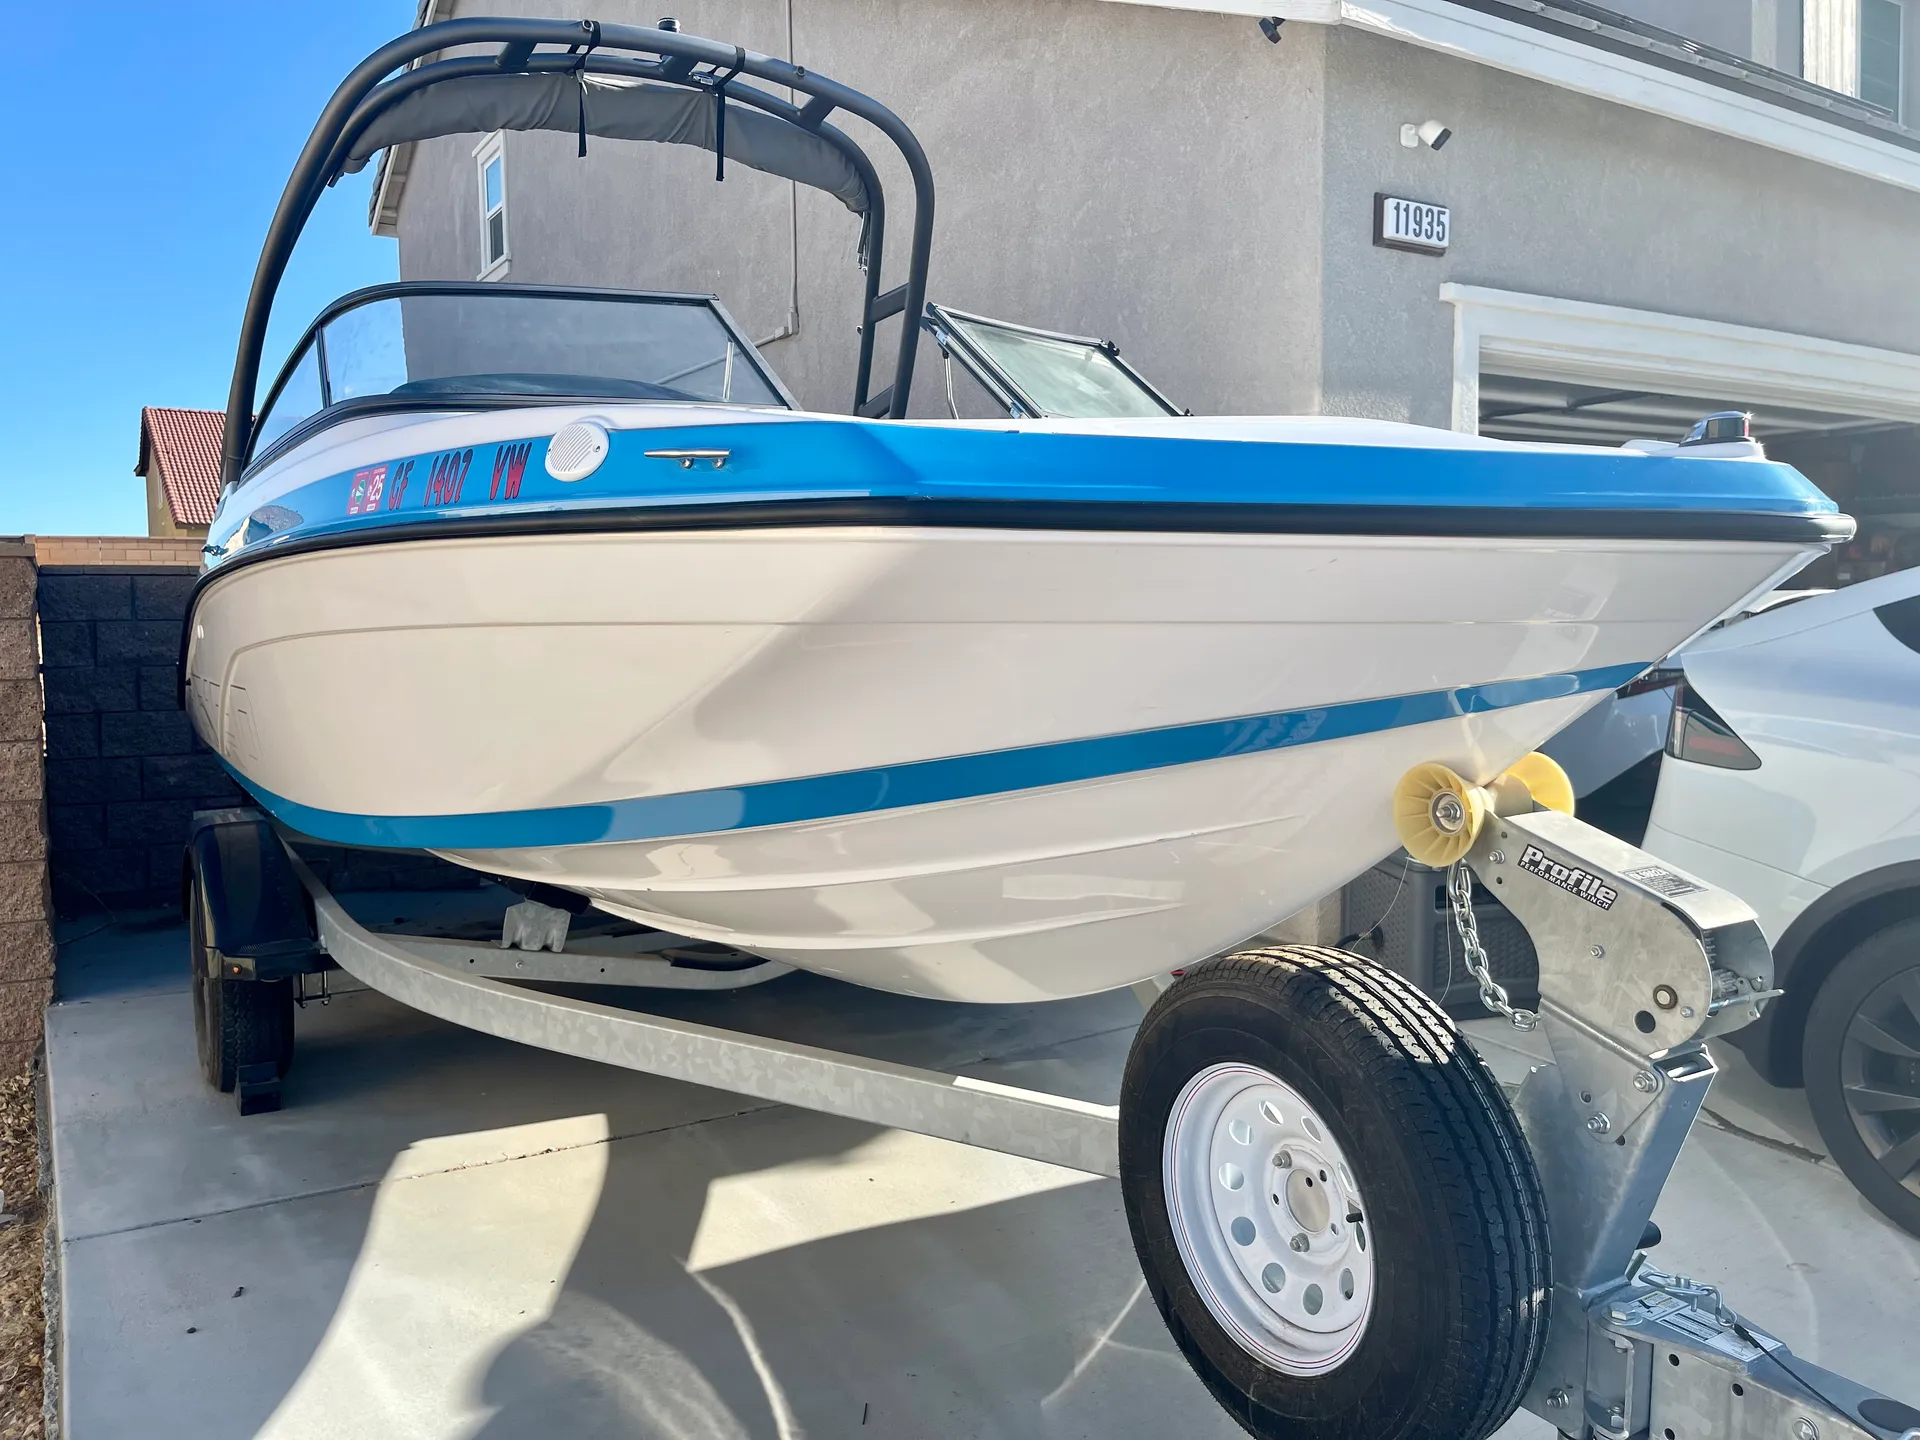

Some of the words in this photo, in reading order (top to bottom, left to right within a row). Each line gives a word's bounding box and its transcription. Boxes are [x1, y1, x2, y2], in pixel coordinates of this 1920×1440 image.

[1394, 202, 1446, 241] 11935
[370, 474, 385, 501] 25
[389, 460, 415, 511] CF
[424, 449, 473, 507] 1407
[490, 442, 532, 500] VW
[1520, 861, 1577, 894] PERFORMANCE
[1580, 891, 1609, 909] WINCH
[1521, 846, 1617, 904] Profile
